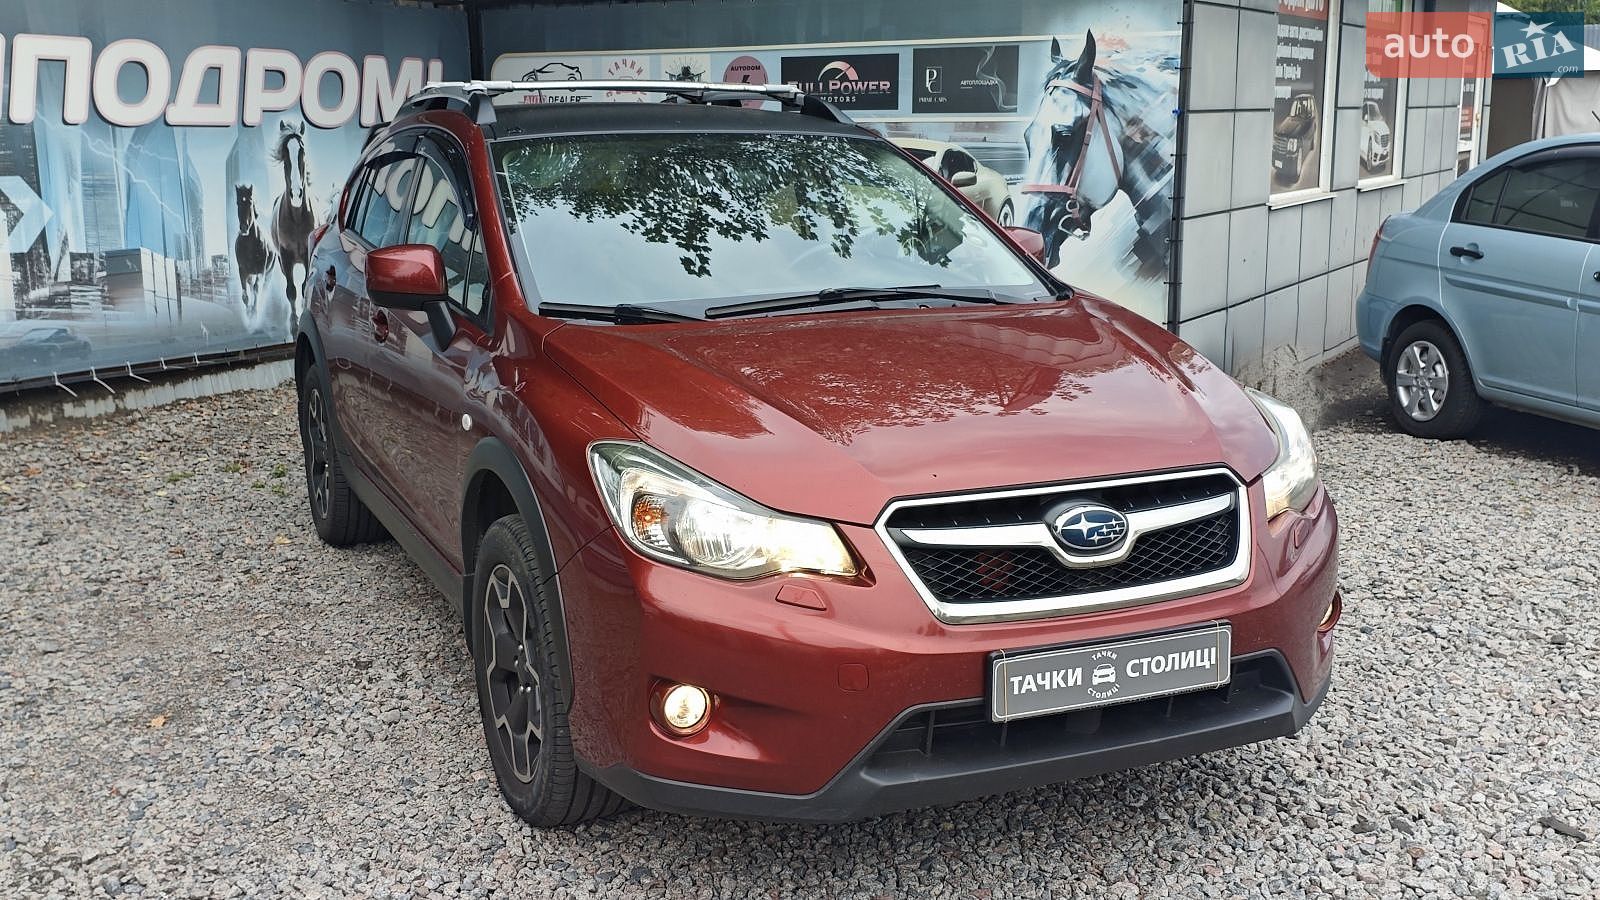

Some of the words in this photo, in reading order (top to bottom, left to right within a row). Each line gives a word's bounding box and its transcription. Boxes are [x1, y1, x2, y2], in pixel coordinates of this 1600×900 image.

[608, 58, 644, 76] ТАЧКИ
[0, 33, 444, 128] ПОДРОМ
[829, 79, 892, 94] POWER
[548, 95, 582, 103] DEALER
[1092, 650, 1118, 661] ТАЧКИ
[1010, 667, 1083, 695] ТАЧКИ
[1126, 647, 1217, 678] СТОЛИЦІ
[1087, 683, 1121, 699] СТОЛИЦІ
